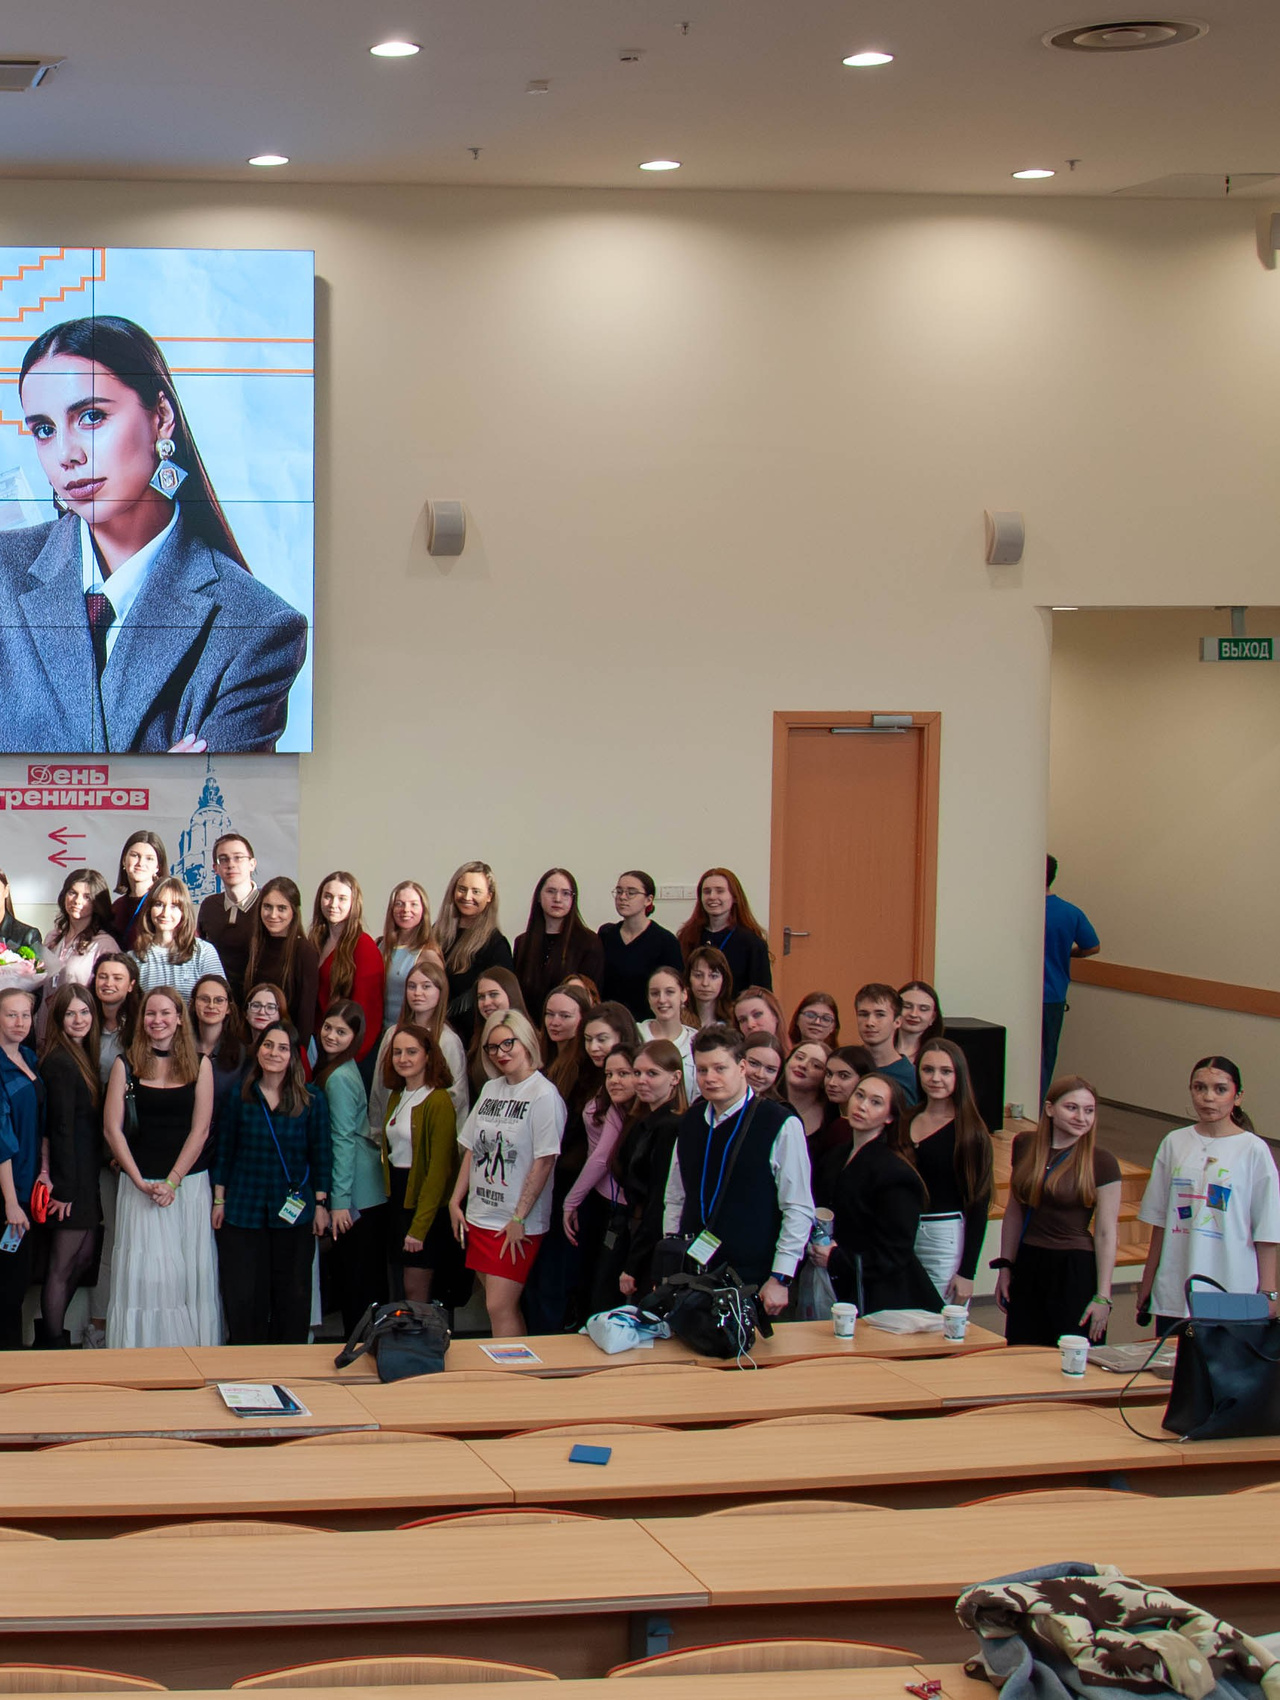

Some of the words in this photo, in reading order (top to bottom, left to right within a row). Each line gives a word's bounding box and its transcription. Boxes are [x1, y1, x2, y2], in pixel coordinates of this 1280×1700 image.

[1222, 641, 1269, 658] ВЫХОД
[30, 765, 106, 785] День
[504, 1099, 530, 1119] TIME
